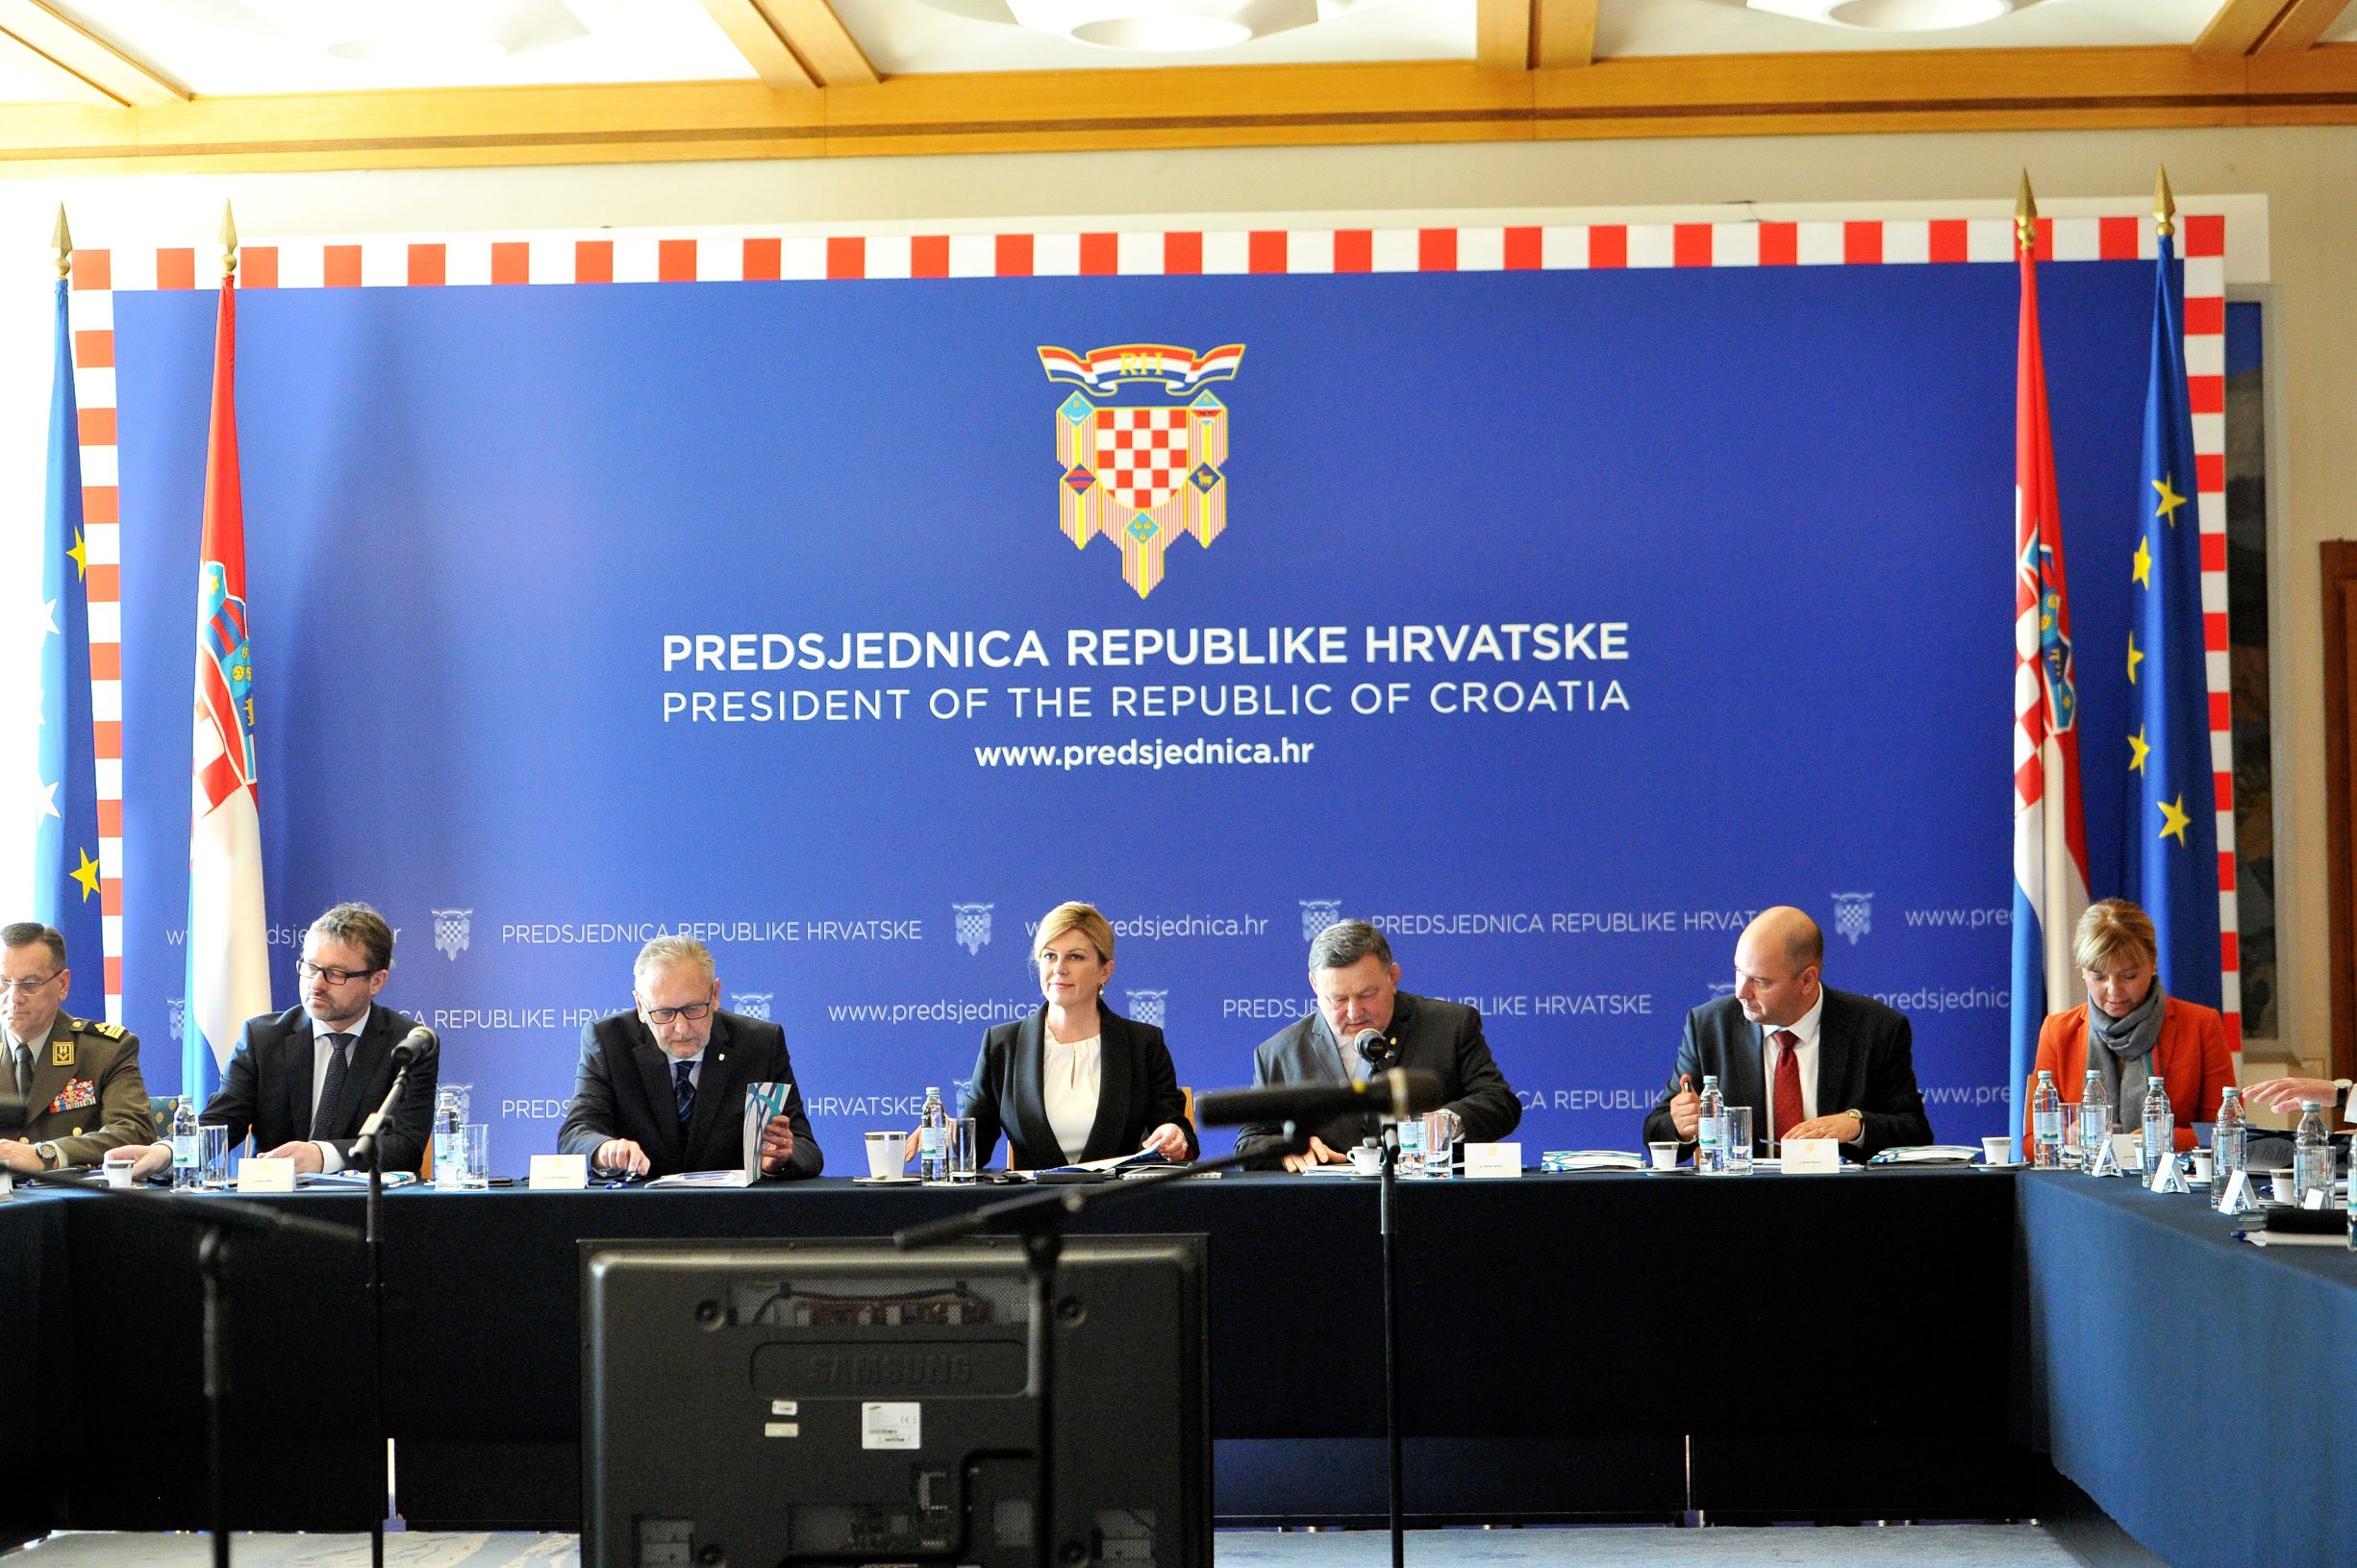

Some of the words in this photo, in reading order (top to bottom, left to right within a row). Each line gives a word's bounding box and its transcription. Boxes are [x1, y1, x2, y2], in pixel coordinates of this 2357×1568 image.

[1119, 352, 1164, 376] RH
[664, 630, 1049, 672] PREDSJEDNICA
[1068, 626, 1347, 667] REPUBLIKE
[1366, 622, 1629, 663] HRVATSKE
[664, 689, 911, 723] PRESIDENT
[930, 687, 989, 720] OF
[1007, 686, 1092, 718] THE
[1112, 684, 1332, 717] REPUBLIC
[1350, 683, 1411, 714] OF
[1430, 680, 1630, 713] CROATIA
[974, 737, 1315, 770] www.predsjednica.hr
[1371, 913, 1544, 934] PREDSJEDNICA
[1552, 911, 1676, 933] REPUBLIKE
[1684, 909, 1760, 931] HRVAT
[1905, 908, 2013, 930] www.pre
[502, 923, 668, 944] PREDSJEDNICA
[678, 921, 799, 942] REPUBLIKE
[807, 920, 922, 940] HRVATSKE
[1535, 994, 1652, 1014] HRVATSKE
[435, 1008, 555, 1029] REPUBLIKE
[808, 1096, 922, 1116] HRVATSKE
